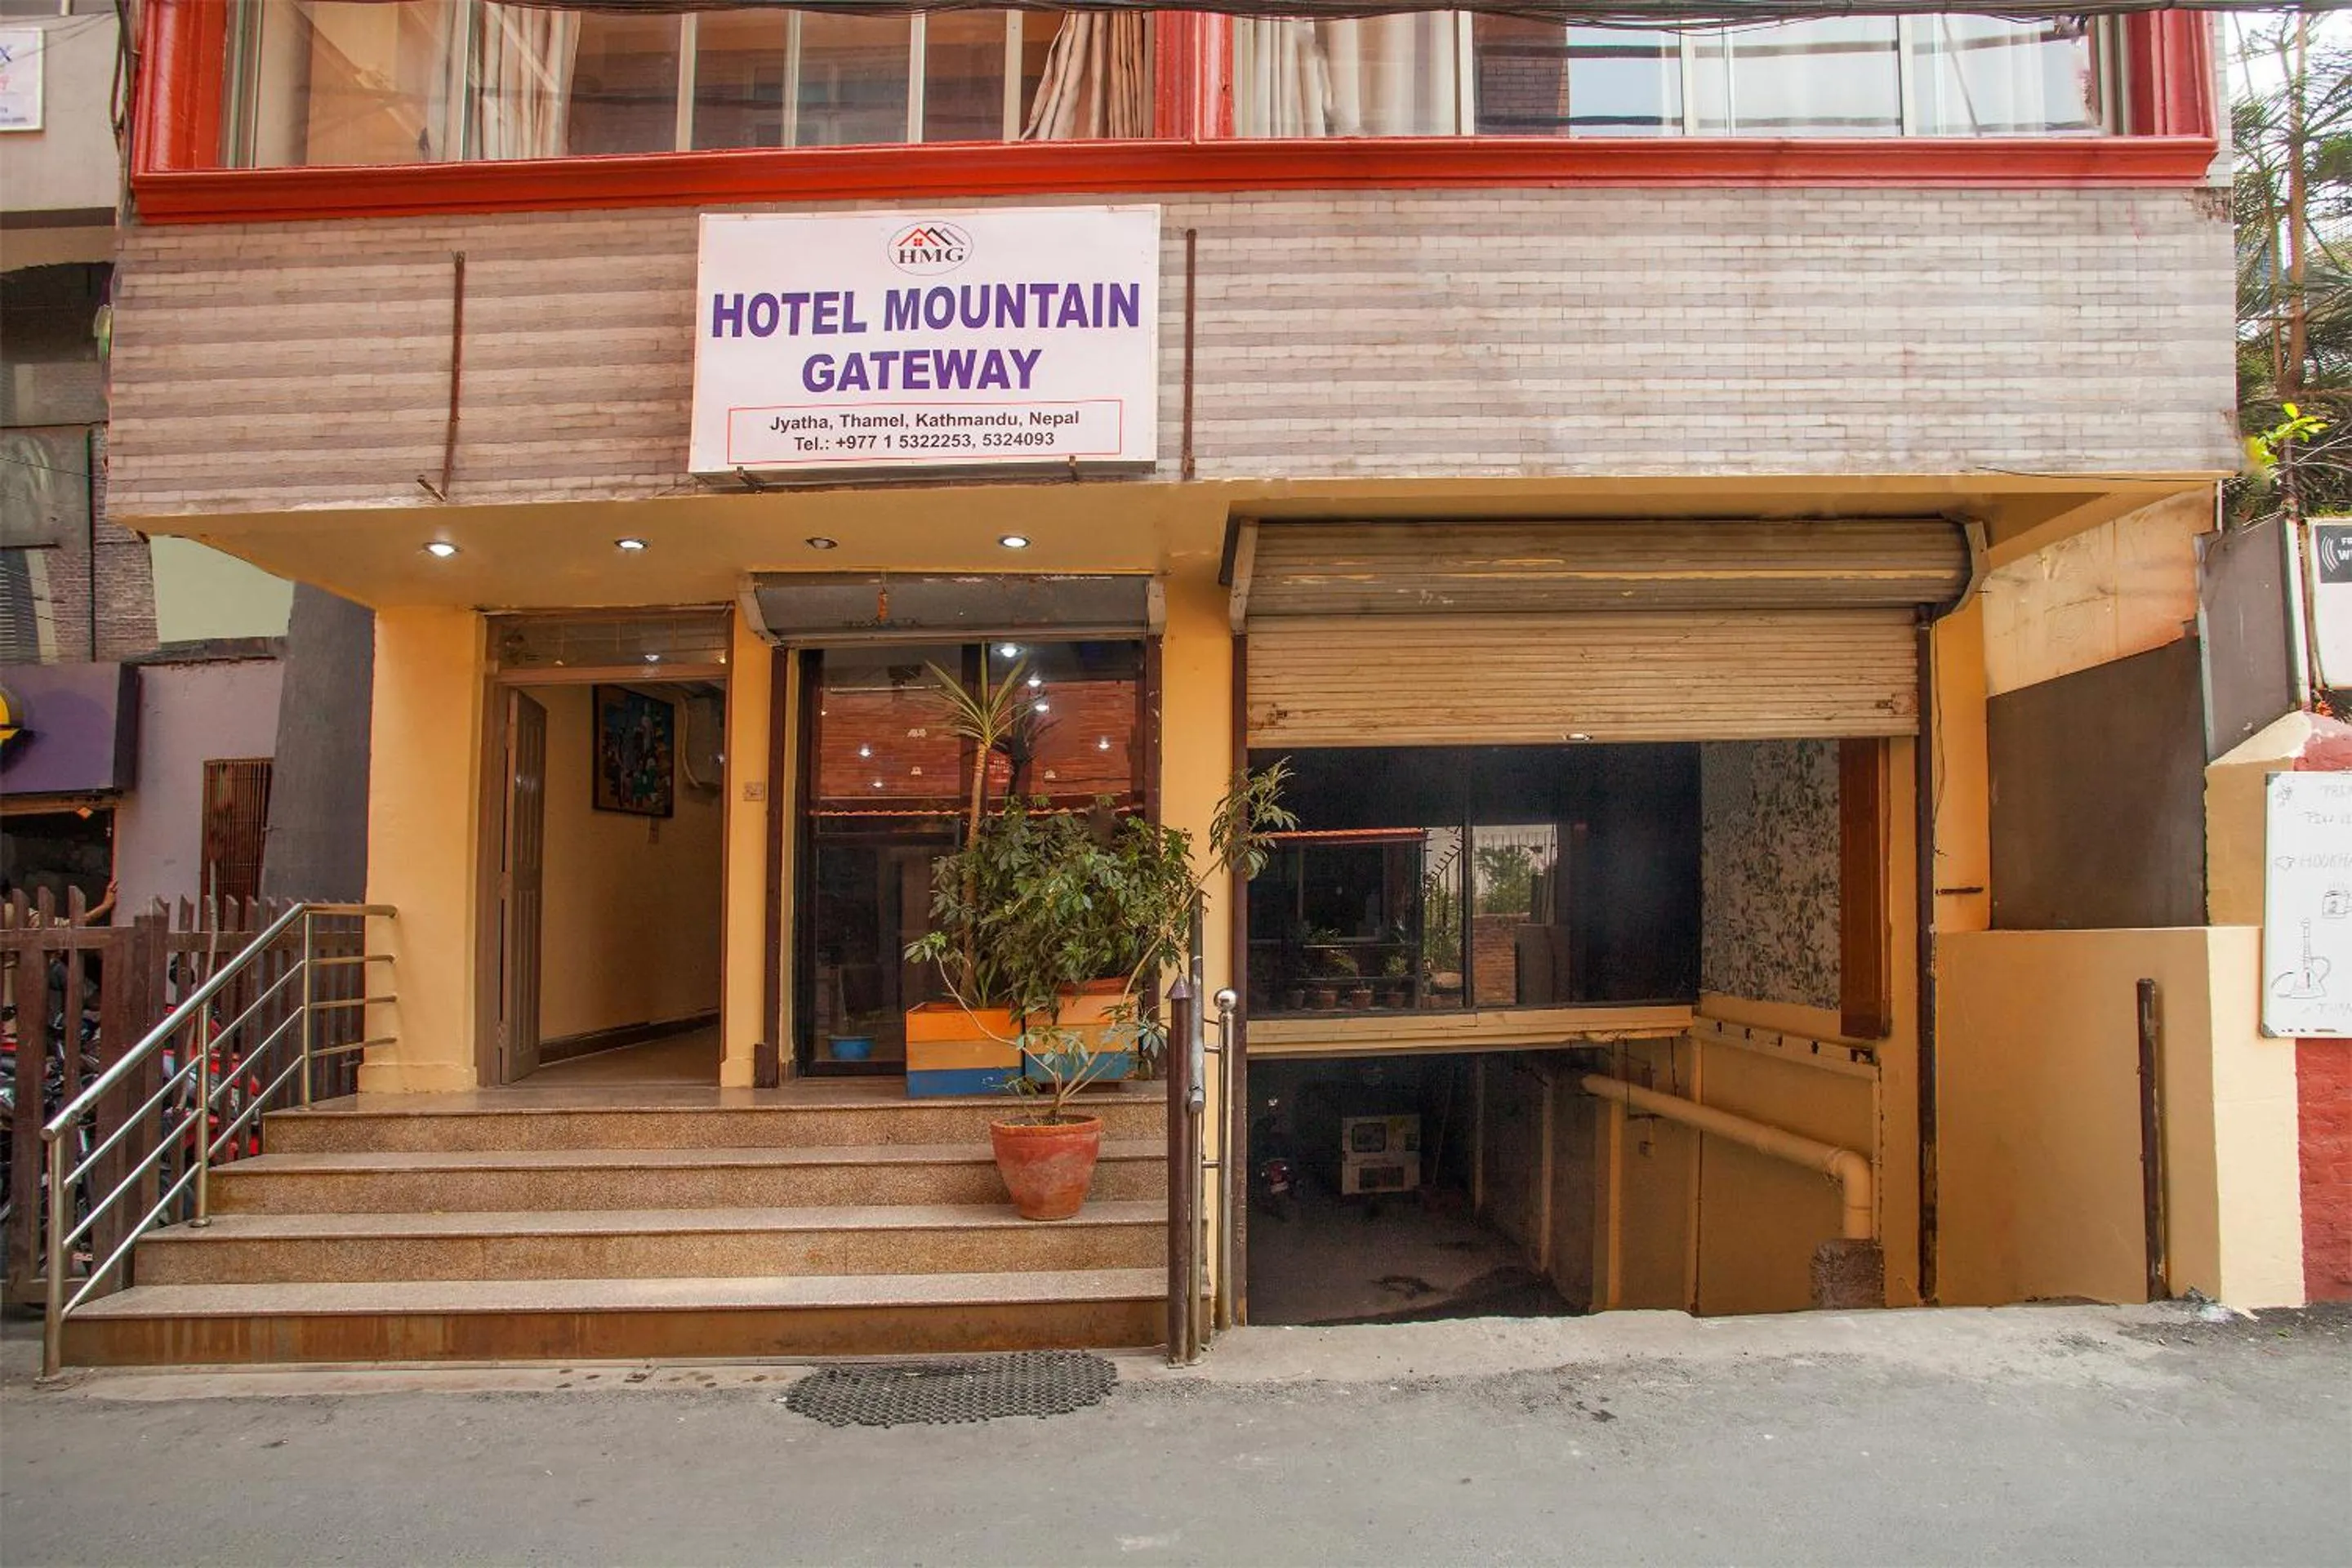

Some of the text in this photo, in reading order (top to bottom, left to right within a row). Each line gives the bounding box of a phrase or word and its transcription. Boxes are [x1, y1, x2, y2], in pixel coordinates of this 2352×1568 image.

[898, 247, 964, 265] HMG
[712, 283, 1139, 337] HOTEL MOUNTAIN
[802, 349, 1042, 392] GATEWAY
[770, 410, 1080, 433] Jyatha, Thamel, Kathmandu, Nepal
[794, 431, 1055, 451] Tel.: +977 1 5322253, 5324093
